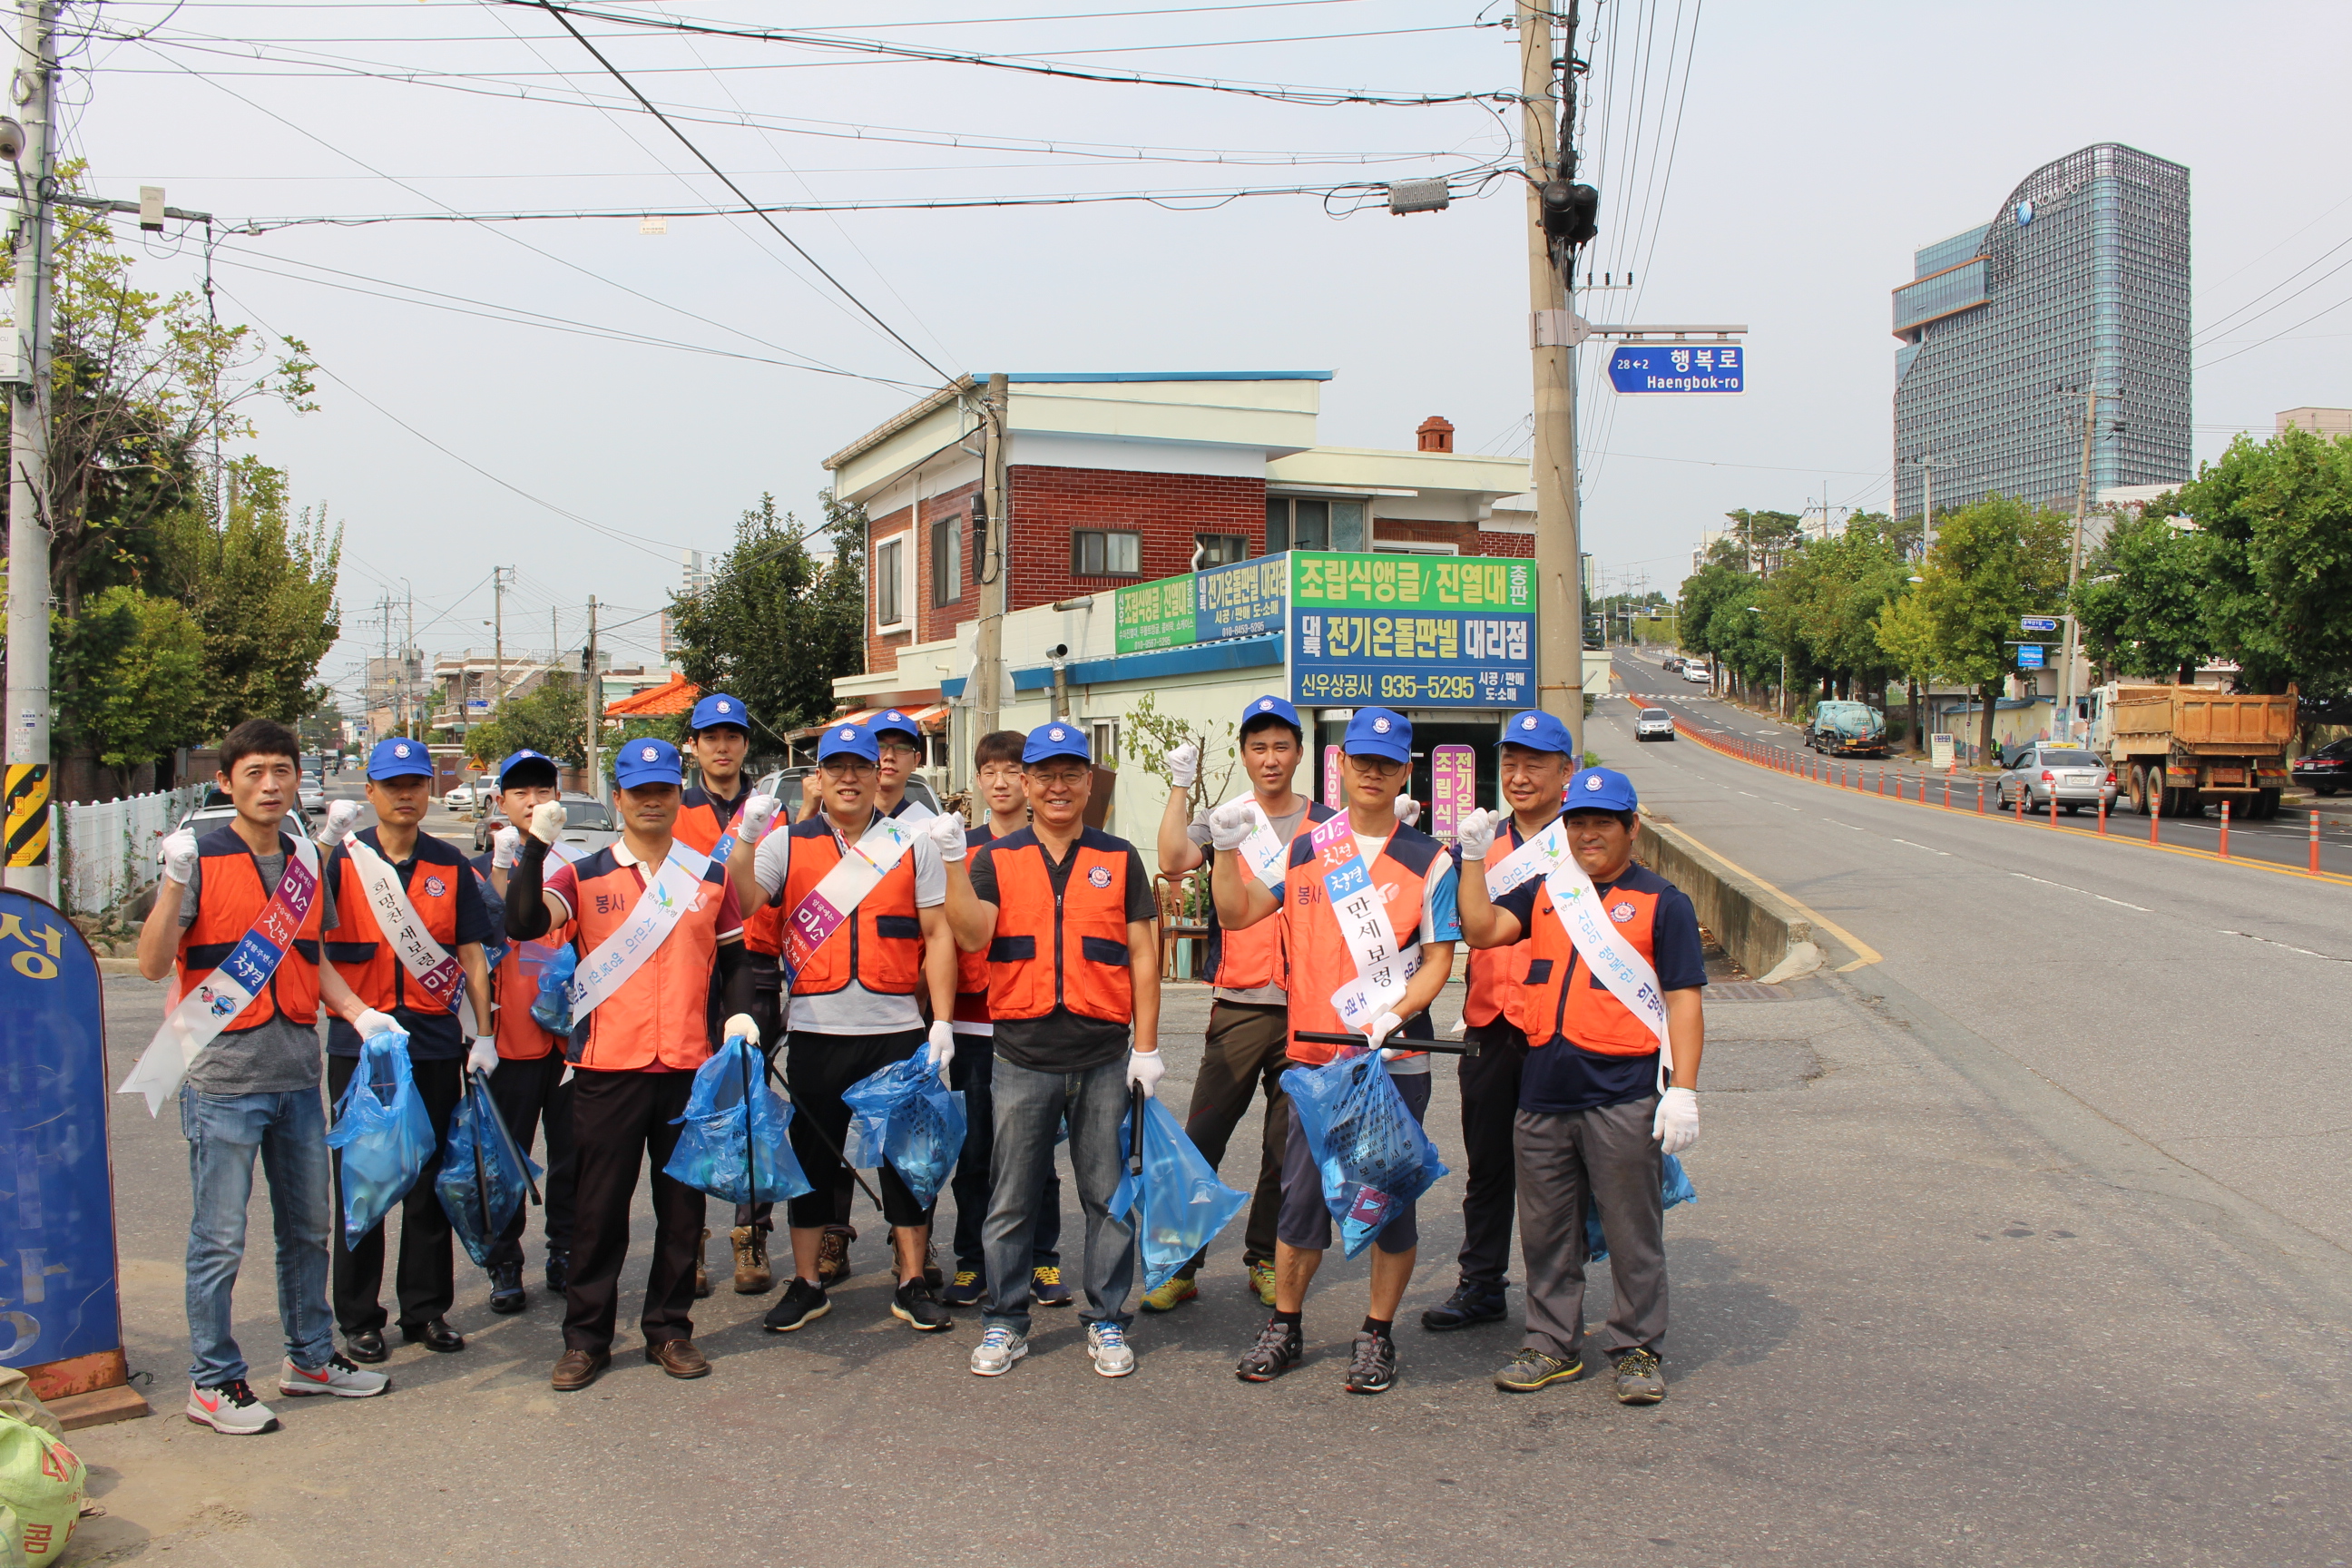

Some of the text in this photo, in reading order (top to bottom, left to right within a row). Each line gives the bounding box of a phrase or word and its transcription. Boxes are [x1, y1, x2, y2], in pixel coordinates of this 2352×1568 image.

[2034, 181, 2079, 210] KOMIPO
[2035, 200, 2068, 219] 한국중부발전
[1671, 349, 1739, 373] 행복로
[1647, 375, 1739, 392] Haengbok-ro
[1199, 559, 1286, 612] 대륙 전기온돌판넬 대리점
[1300, 559, 1420, 603] 조립식앵글
[1436, 564, 1506, 605] 진열대
[1510, 564, 1528, 606] 총판
[1125, 586, 1160, 624] 조립식앵글
[1163, 581, 1187, 619] 진열대
[1187, 579, 1194, 615] 총판
[1214, 609, 1230, 624] 시공
[1235, 604, 1250, 622] 판매
[1134, 636, 1171, 651] 010-9567-5295
[1221, 621, 1265, 638] 010-8453-5295
[1302, 615, 1527, 661] 대륙 전기온돌판넬 대리점
[1300, 673, 1475, 700] 신우상공사 935-5295
[1479, 671, 1499, 686] 시공
[1505, 672, 1525, 687] 판매
[1313, 820, 1346, 845] 미소
[1323, 843, 1354, 867] 친절
[1331, 865, 1364, 893] 청결
[1501, 860, 1536, 891] 시민이
[284, 877, 308, 912] 미소
[595, 893, 626, 915] 봉사
[1298, 885, 1323, 906] 봉사
[263, 912, 289, 946] 친절
[372, 877, 406, 925] 희망찬
[399, 925, 436, 967] 새보령
[798, 907, 827, 942] 미소
[589, 916, 658, 986] 시민이 행복한
[1577, 908, 1603, 946] 시민이
[1598, 944, 1637, 984] 행복한
[233, 951, 266, 987] 청결
[424, 964, 456, 989] 미소
